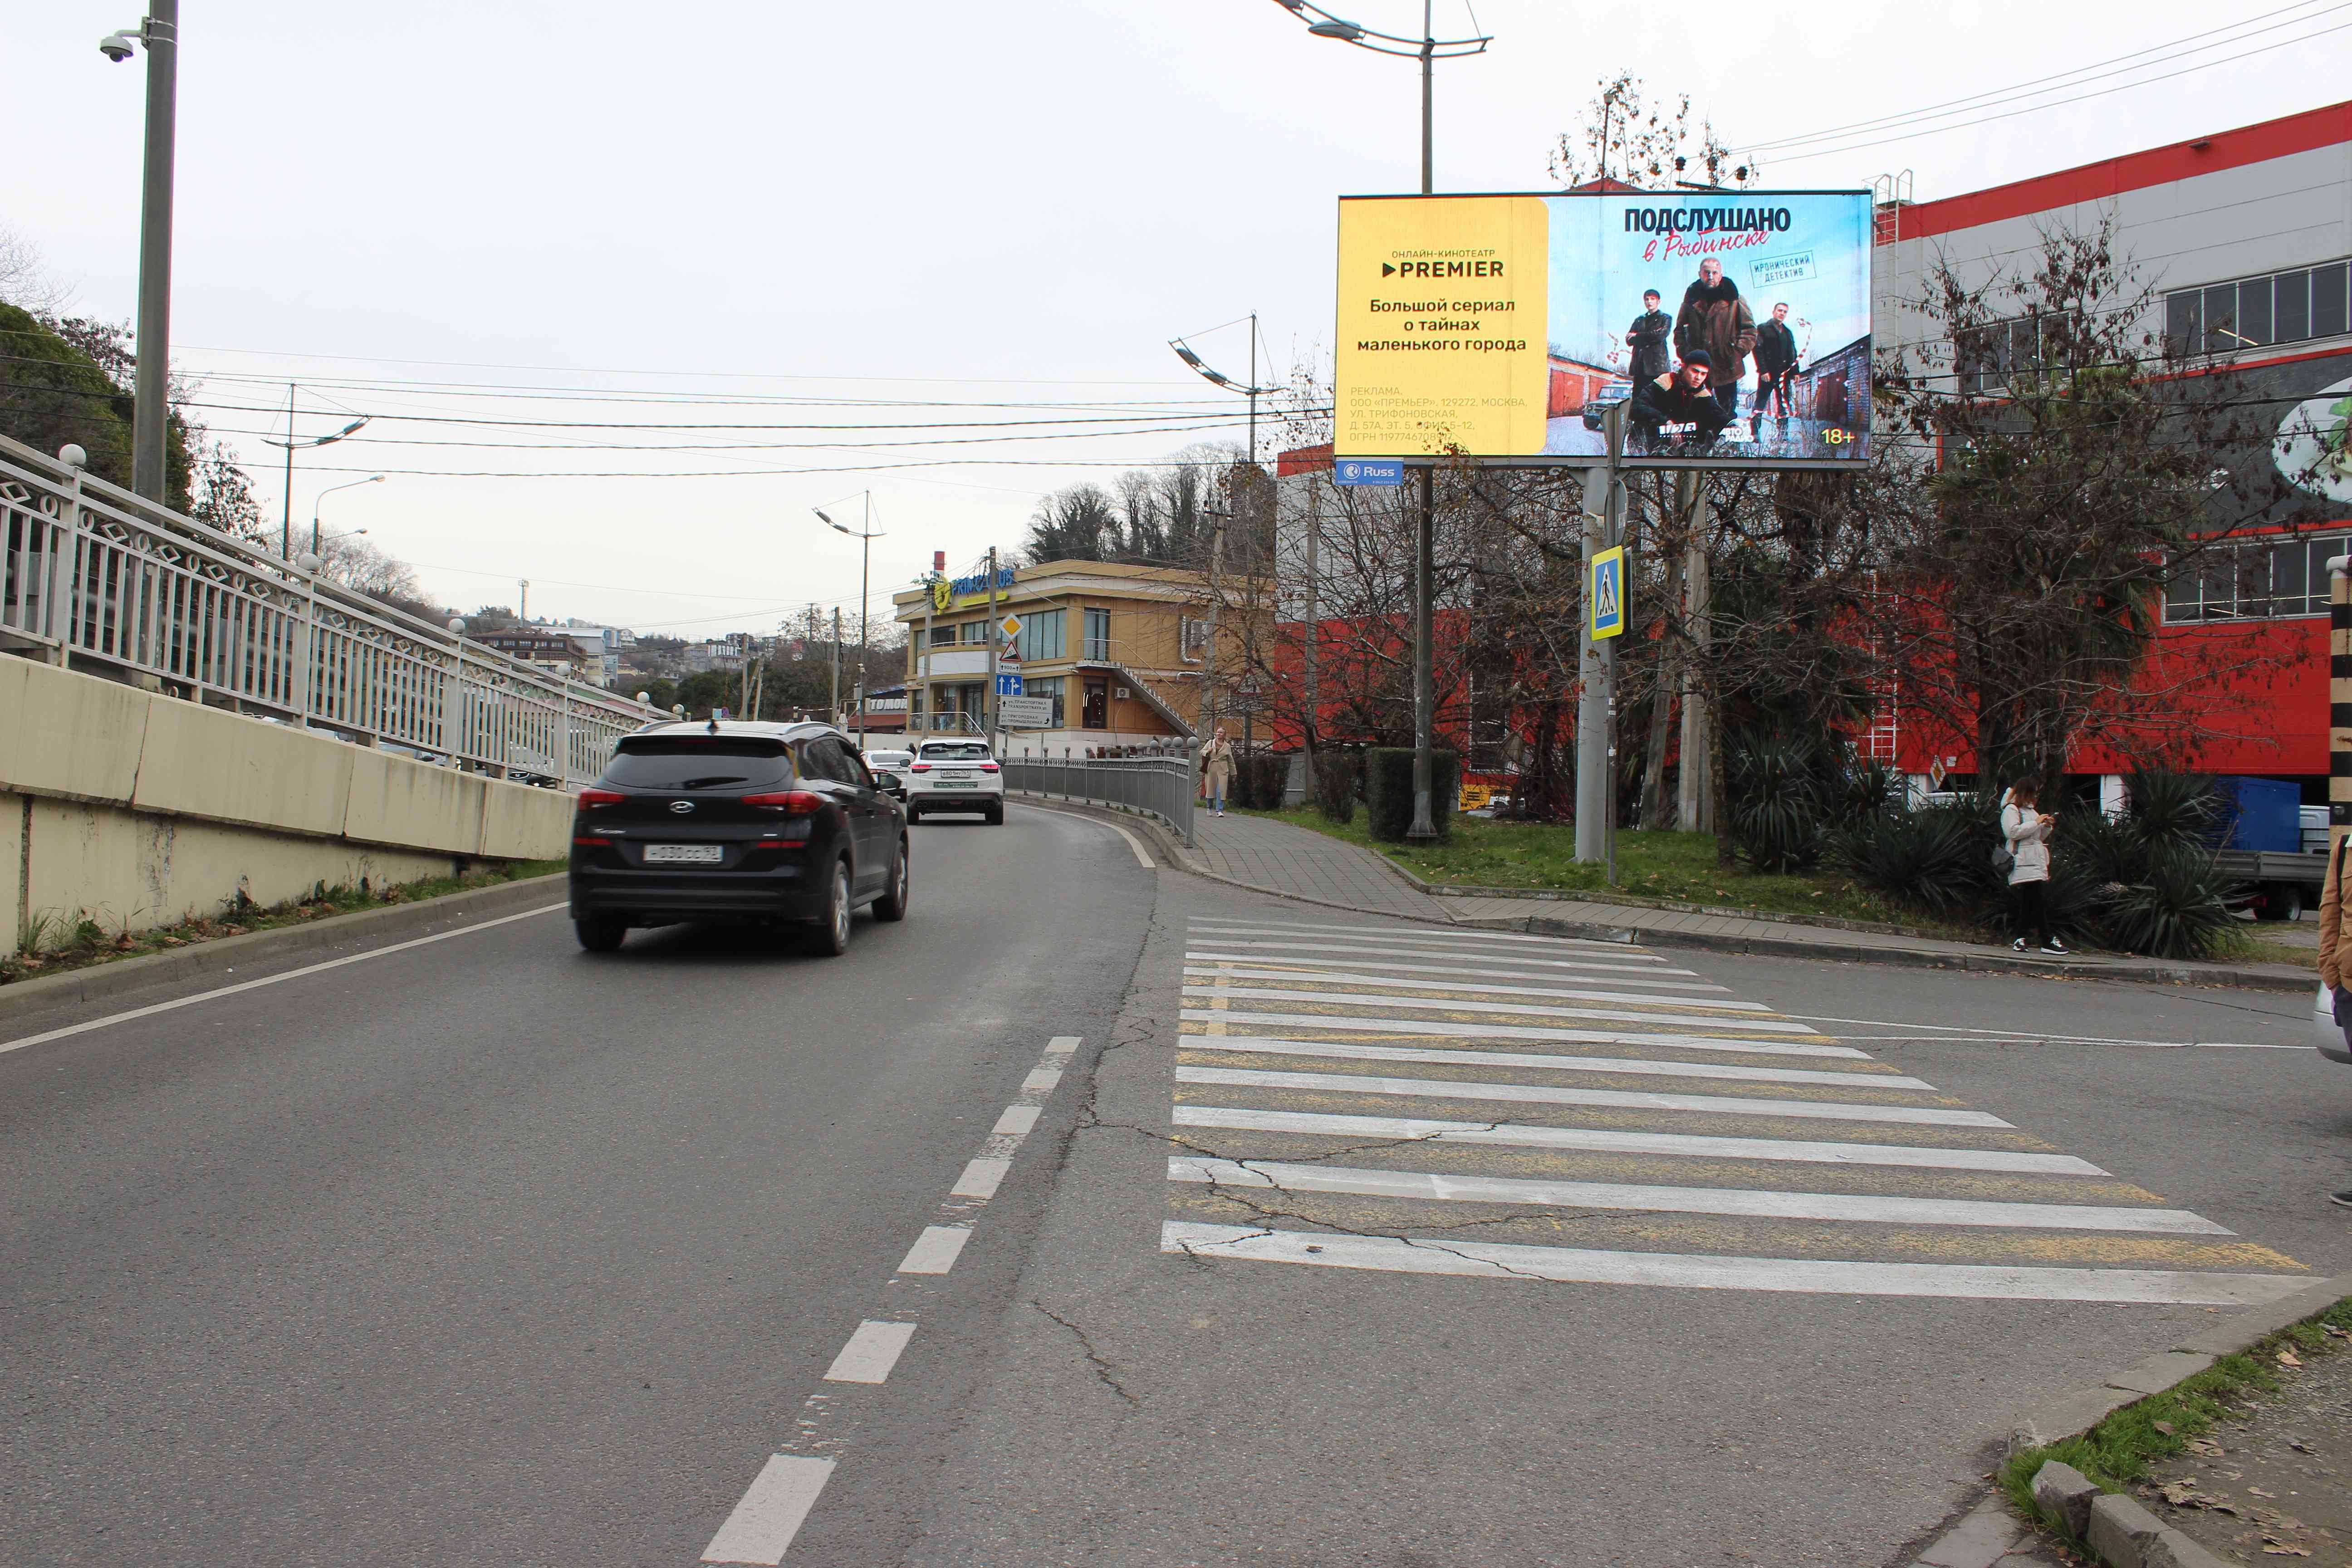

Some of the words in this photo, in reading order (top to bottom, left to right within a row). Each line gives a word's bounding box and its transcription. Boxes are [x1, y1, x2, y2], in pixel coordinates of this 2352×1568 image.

[1625, 208, 1791, 236] ПОДСЛУШАНО
[1642, 239, 1658, 262] в
[1662, 225, 1771, 261] Рыбинске
[1392, 249, 1495, 258] ОНЛАЙН-КИНОТЕАТР
[1400, 261, 1504, 277] PREMIER
[1754, 255, 1810, 273] ИРОНИЧЕСКИЙ
[1765, 268, 1803, 283] ДЕТЕКТИВ
[1370, 299, 1447, 312] Большой
[1452, 300, 1515, 314] сериал
[1404, 321, 1414, 331] о
[1419, 317, 1480, 331] тайнах
[1357, 339, 1460, 351] маленького
[1465, 338, 1526, 353] города
[1351, 387, 1402, 395] РЕКЛАМА.
[1441, 398, 1478, 407] 129272,
[1482, 398, 1528, 407] МОСКВА,
[1350, 410, 1366, 418] УЛ.
[1369, 410, 1458, 418] ТРИФОНОВСКАЯ,
[1387, 421, 1402, 430] ЭТ.
[1719, 428, 1742, 436] АВТО
[1821, 428, 1855, 444] 18+
[1364, 466, 1394, 477] Russ
